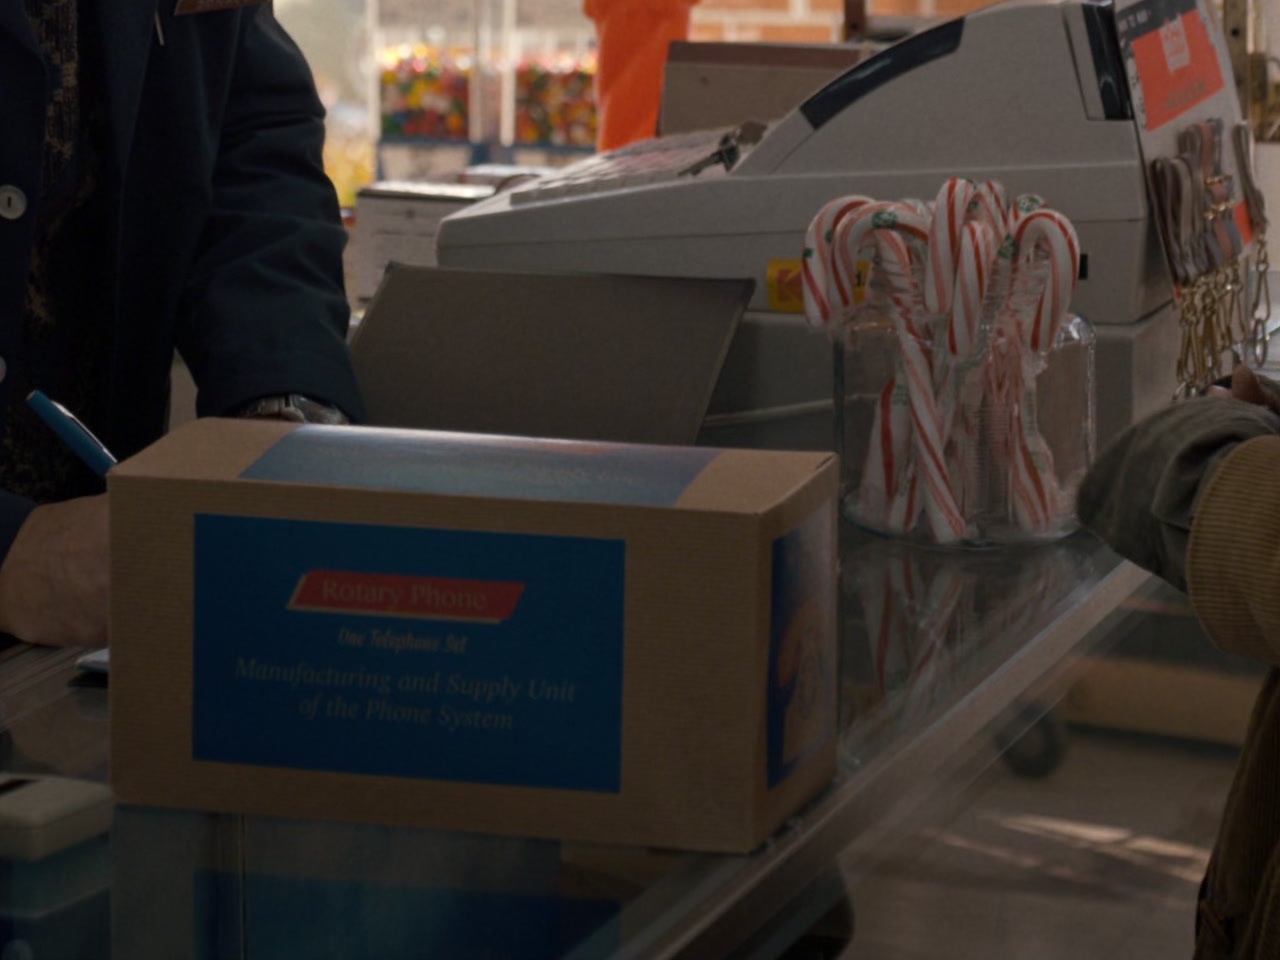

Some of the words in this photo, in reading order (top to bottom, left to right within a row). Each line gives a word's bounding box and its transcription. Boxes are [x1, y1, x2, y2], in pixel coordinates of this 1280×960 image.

[322, 579, 401, 612] Rotary
[411, 584, 486, 610] Phone
[234, 657, 391, 695] Manufacturing
[397, 672, 439, 693] and
[447, 672, 519, 704] Supply
[528, 678, 577, 704] Unit
[298, 694, 323, 719] of
[326, 696, 359, 719] the
[365, 700, 431, 727] Phone
[438, 706, 514, 733] System
